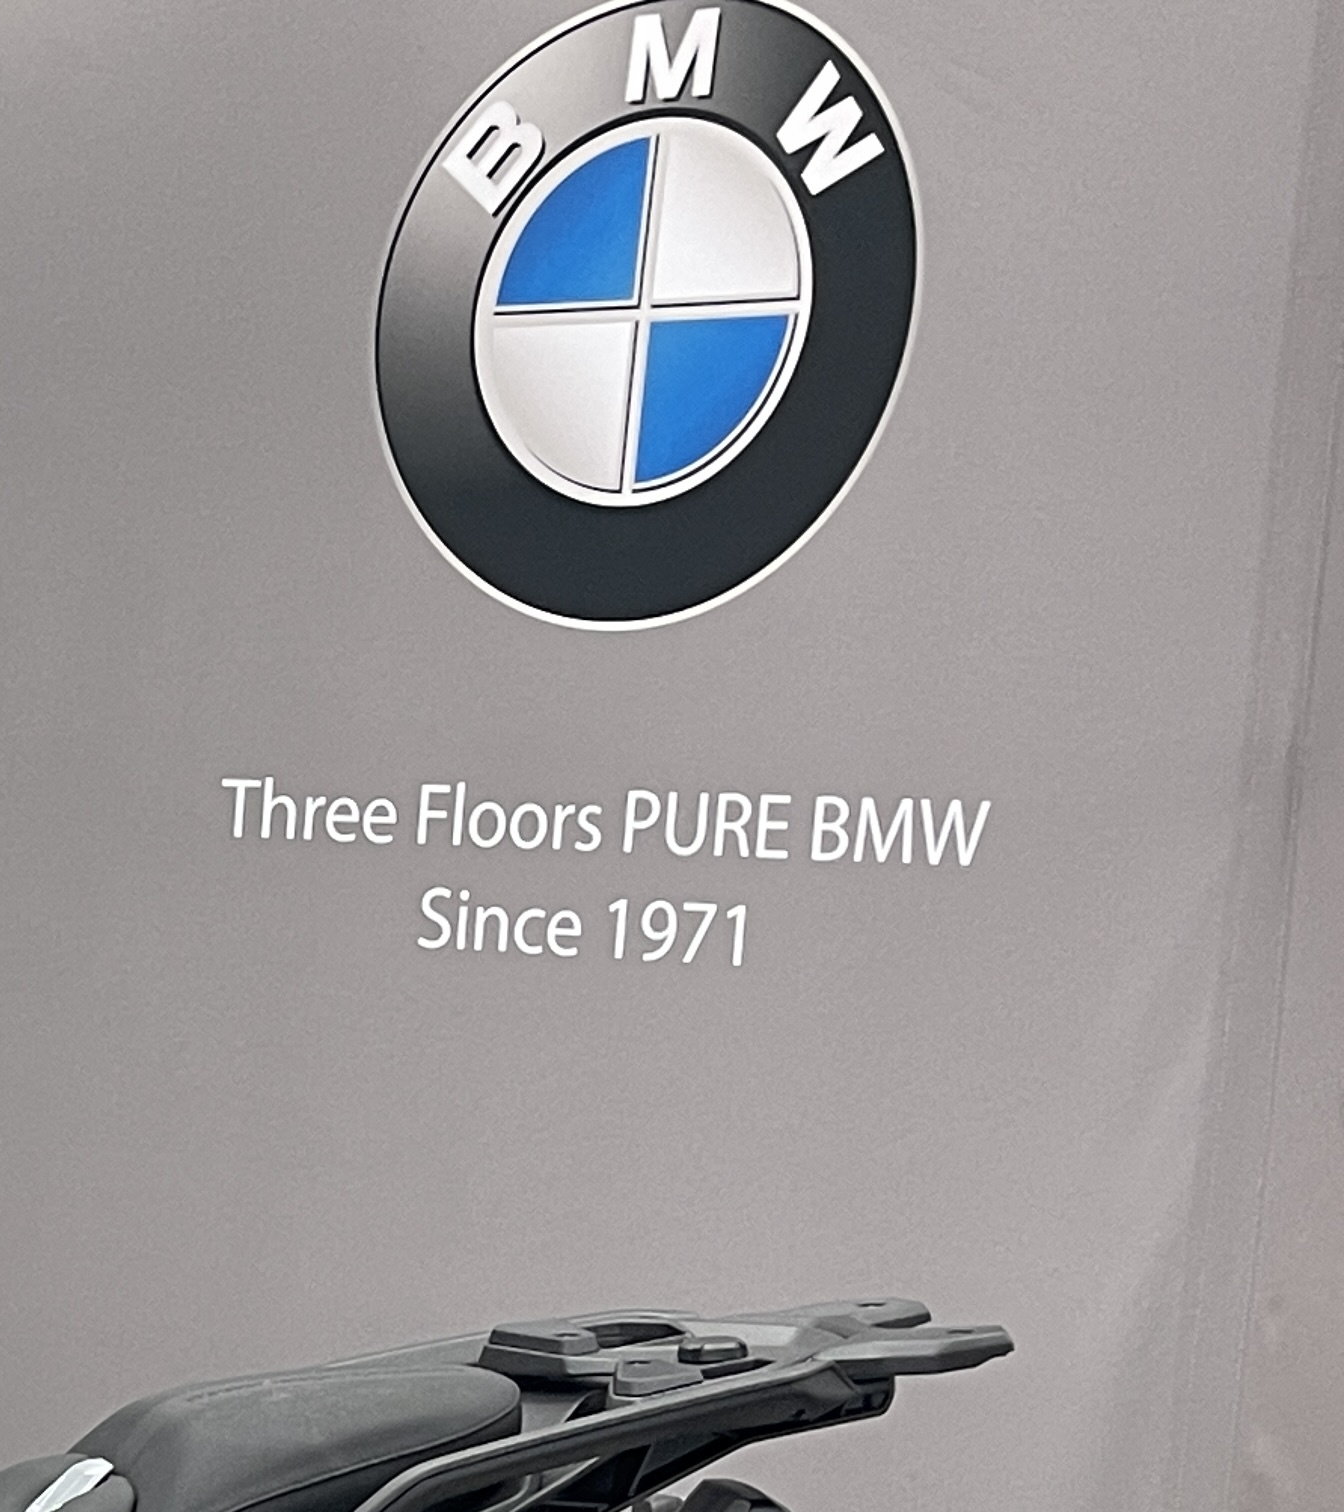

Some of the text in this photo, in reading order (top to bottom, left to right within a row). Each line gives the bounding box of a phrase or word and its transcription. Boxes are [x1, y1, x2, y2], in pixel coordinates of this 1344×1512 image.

[441, 9, 886, 215] BMW
[220, 775, 993, 868] Three Floors PURE BMW
[416, 885, 749, 968] Since 1971
